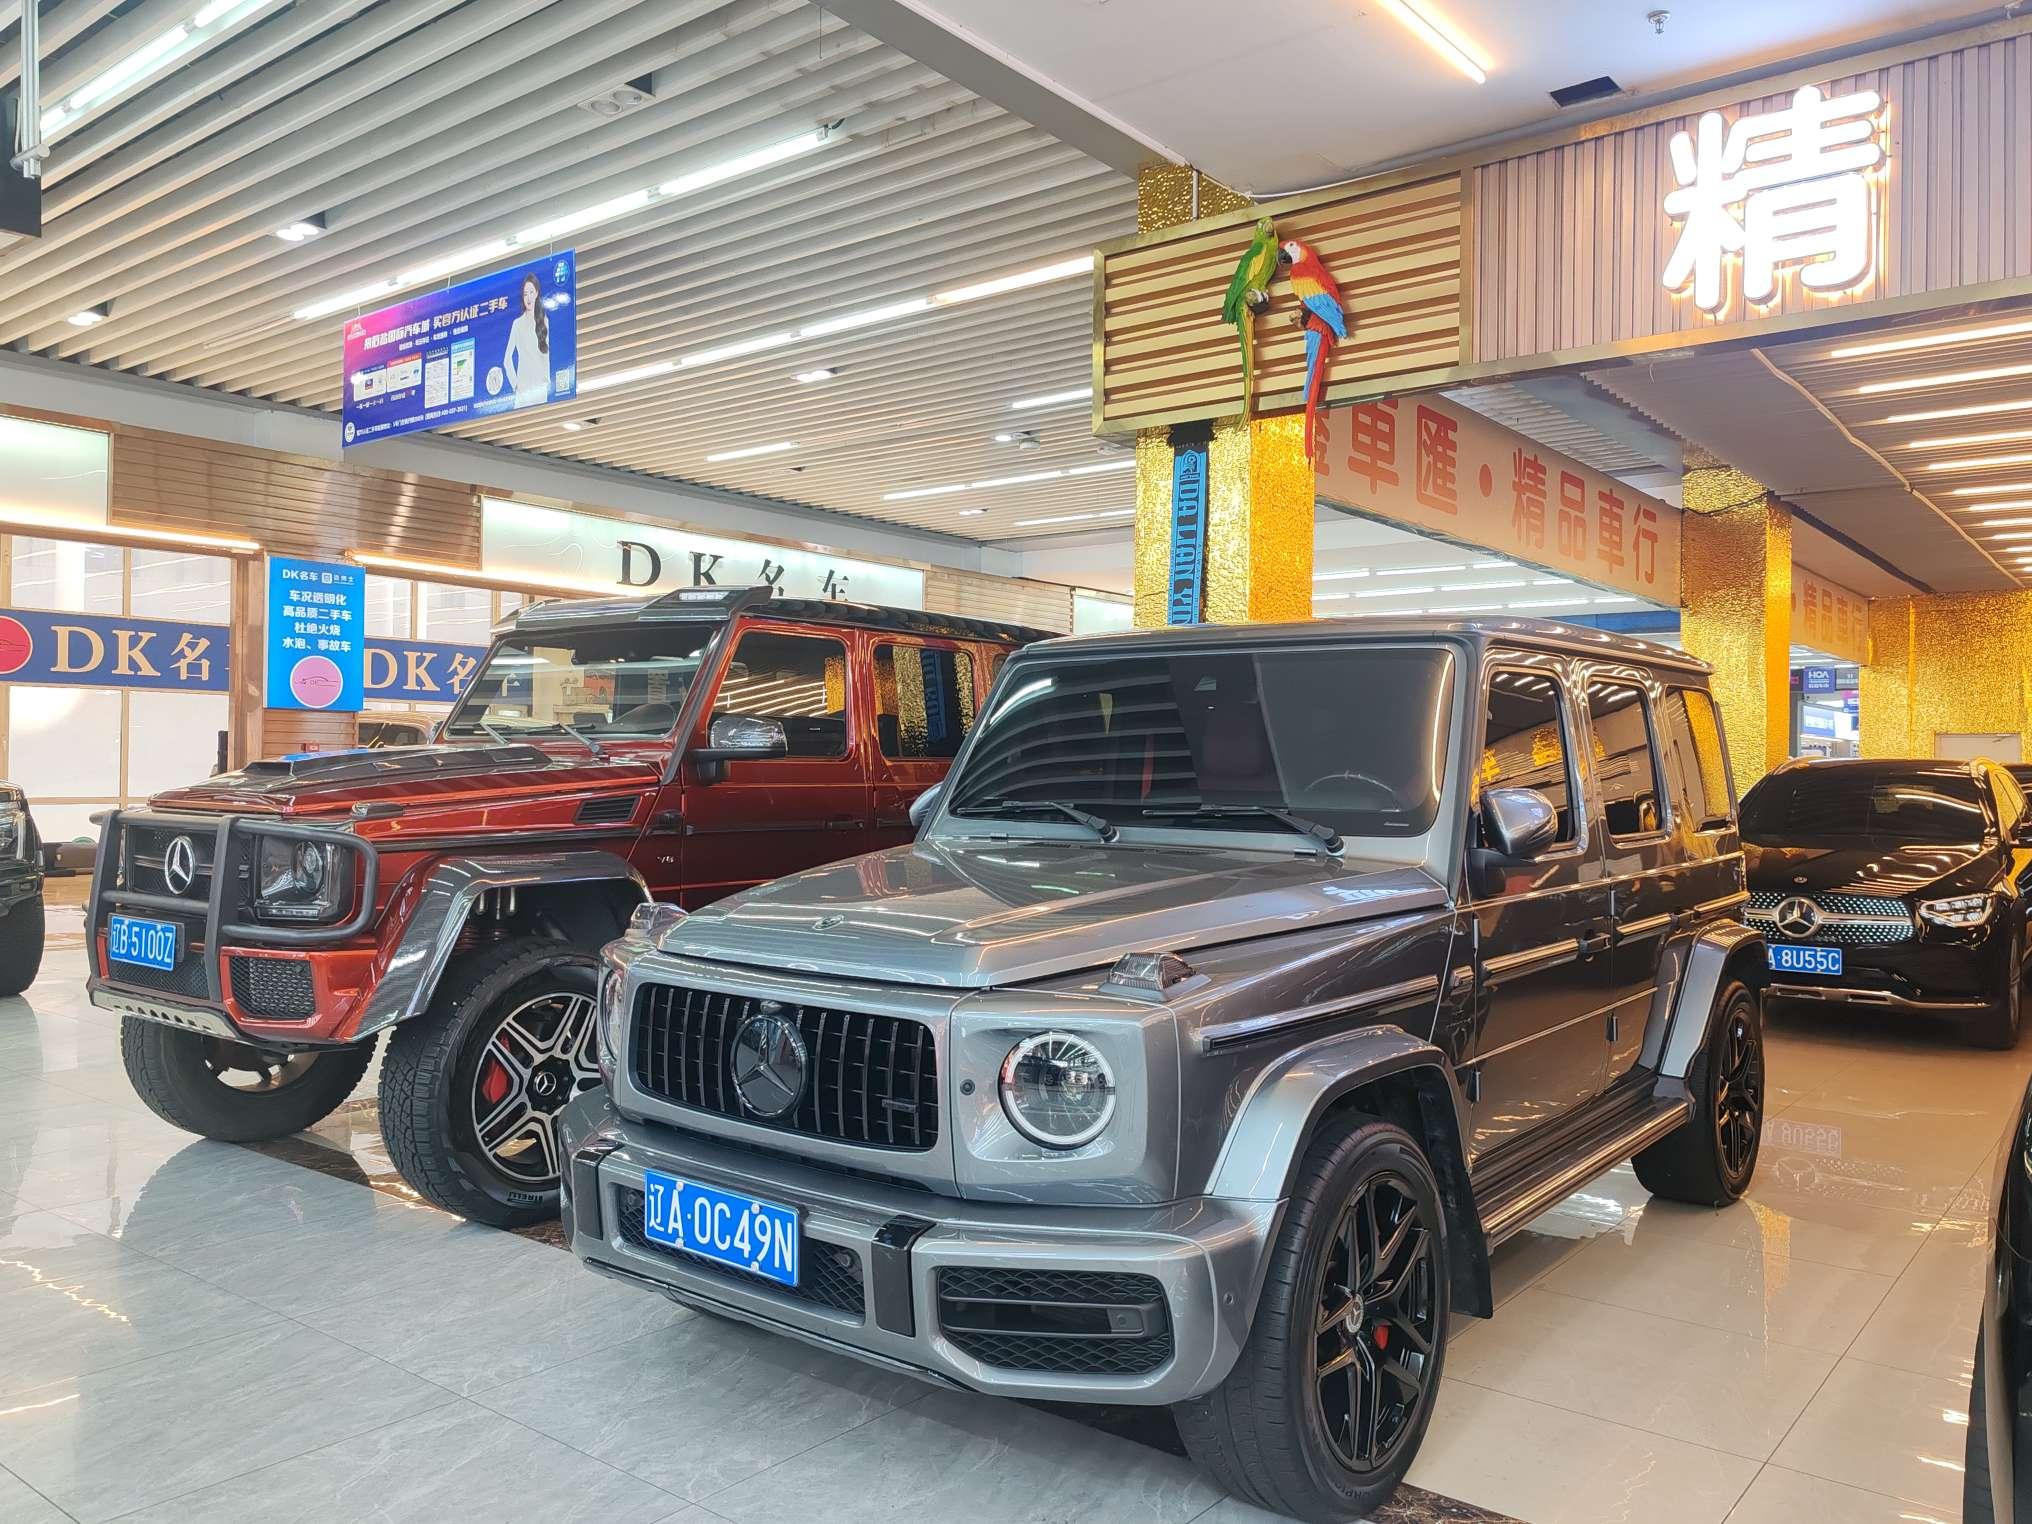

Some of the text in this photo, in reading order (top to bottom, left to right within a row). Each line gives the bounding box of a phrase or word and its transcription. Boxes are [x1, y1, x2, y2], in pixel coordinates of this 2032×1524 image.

[1662, 85, 1883, 312] 精
[282, 569, 318, 581] DK名车
[289, 590, 347, 606] 车况透明化
[282, 605, 352, 621] 高品质二手车
[294, 622, 341, 636] 杜绝火烧
[50, 625, 230, 681] DK名
[282, 637, 352, 653] 水泡、事故车
[649, 1183, 793, 1272] 辽A·0C49N
